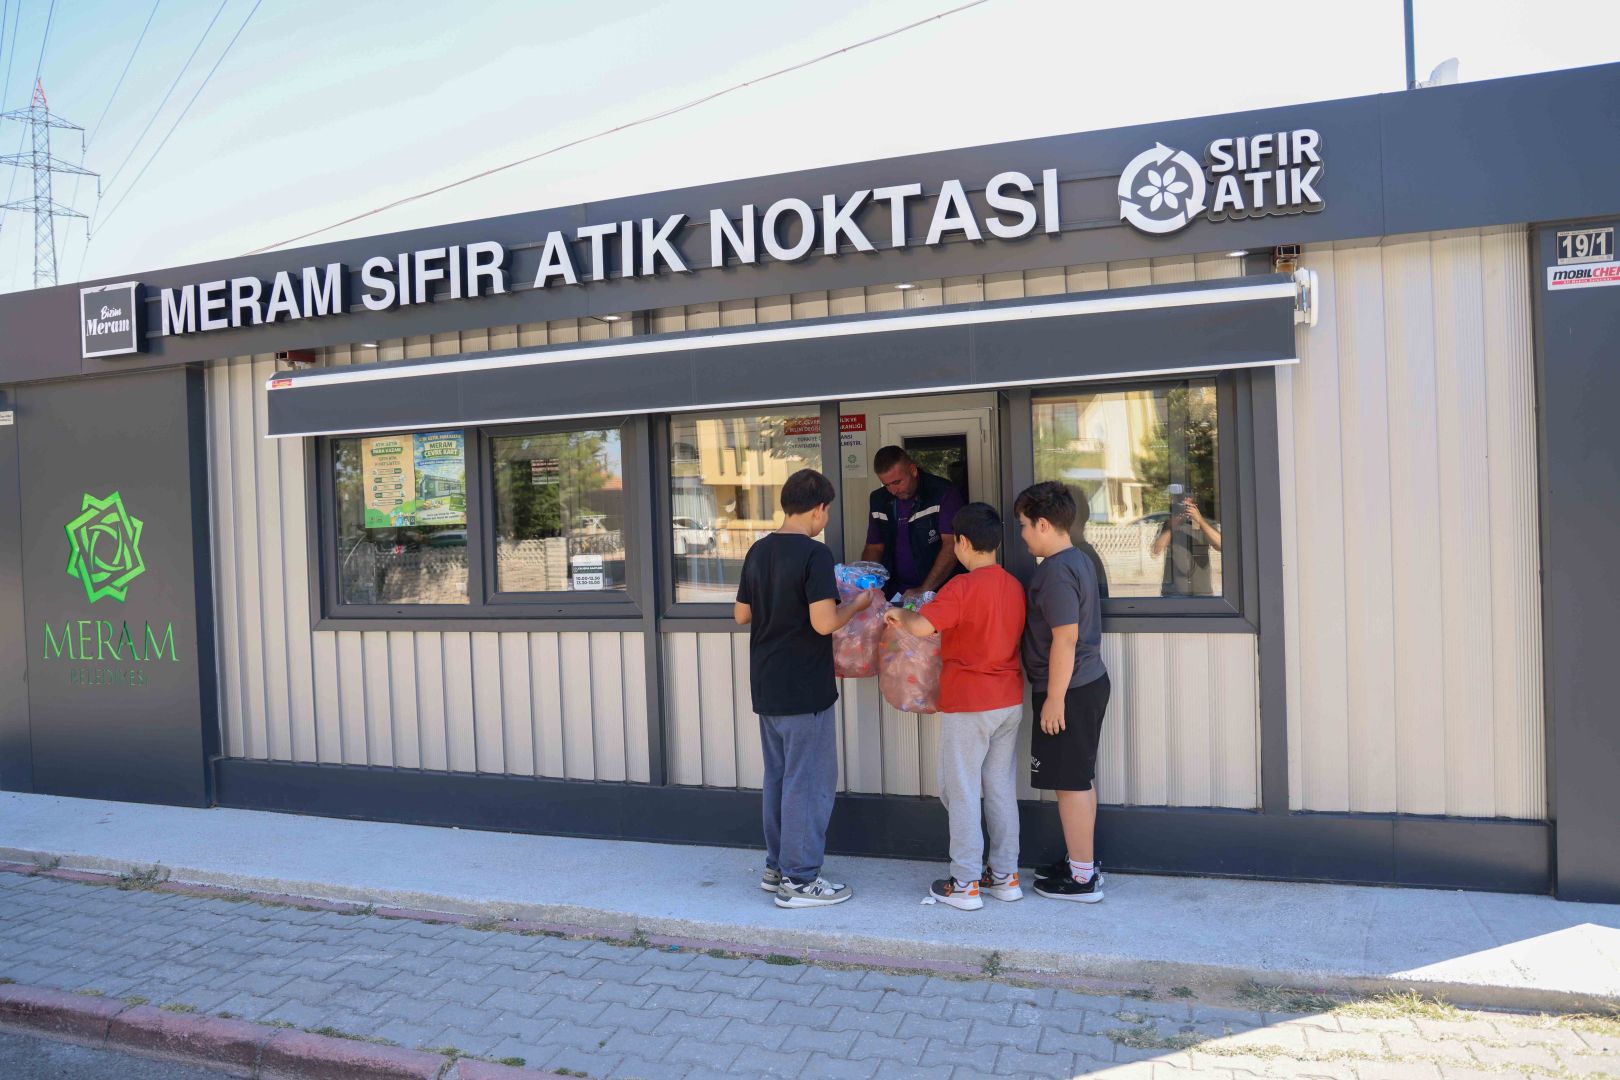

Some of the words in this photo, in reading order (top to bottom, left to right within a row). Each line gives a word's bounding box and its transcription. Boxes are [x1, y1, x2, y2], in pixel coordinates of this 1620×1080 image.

[1210, 129, 1320, 173] SIFIR
[1213, 166, 1322, 212] ATIK
[161, 262, 342, 336] MERAM
[361, 240, 505, 311] SIFIR
[533, 213, 688, 288] ATIK
[709, 168, 1060, 267] NOKTASI
[1562, 232, 1606, 258] 19/1
[86, 318, 130, 337] Meram
[100, 305, 122, 320] Bizim
[430, 441, 453, 449] MERAM
[43, 619, 180, 662] MERAM
